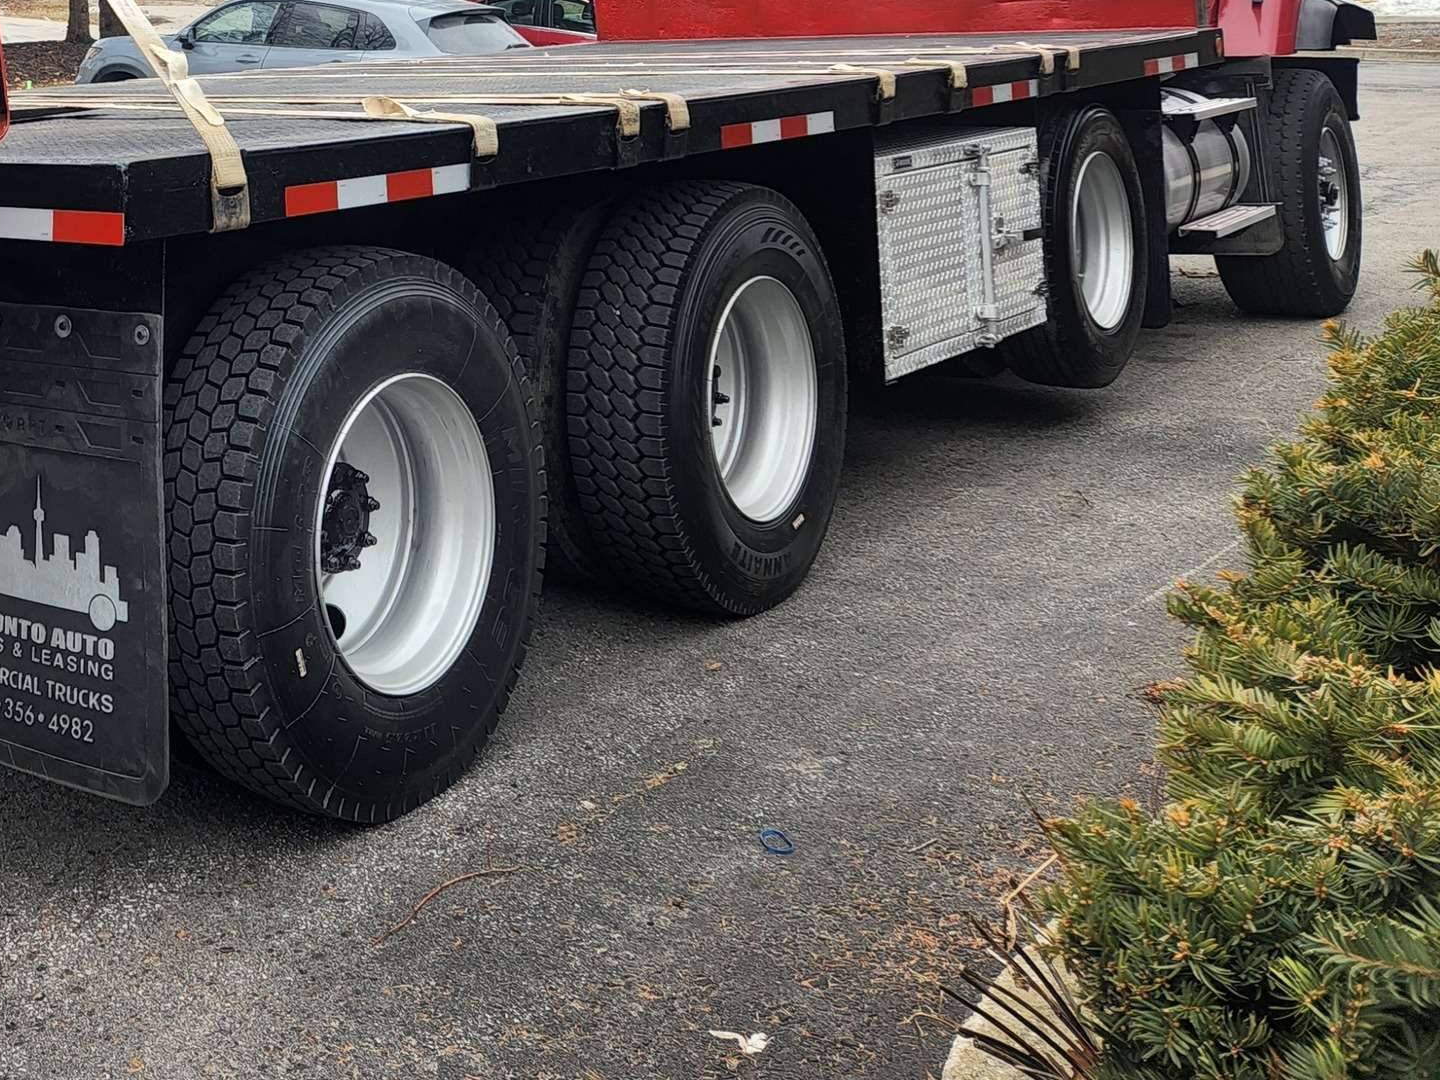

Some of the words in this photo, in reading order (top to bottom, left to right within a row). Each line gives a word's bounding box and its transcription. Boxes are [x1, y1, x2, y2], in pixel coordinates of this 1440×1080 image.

[732, 541, 793, 577] ANNAITE
[12, 642, 23, 658] &
[32, 646, 114, 681] LEASING
[50, 627, 115, 661] AUTO
[46, 679, 114, 713] TRUCKS
